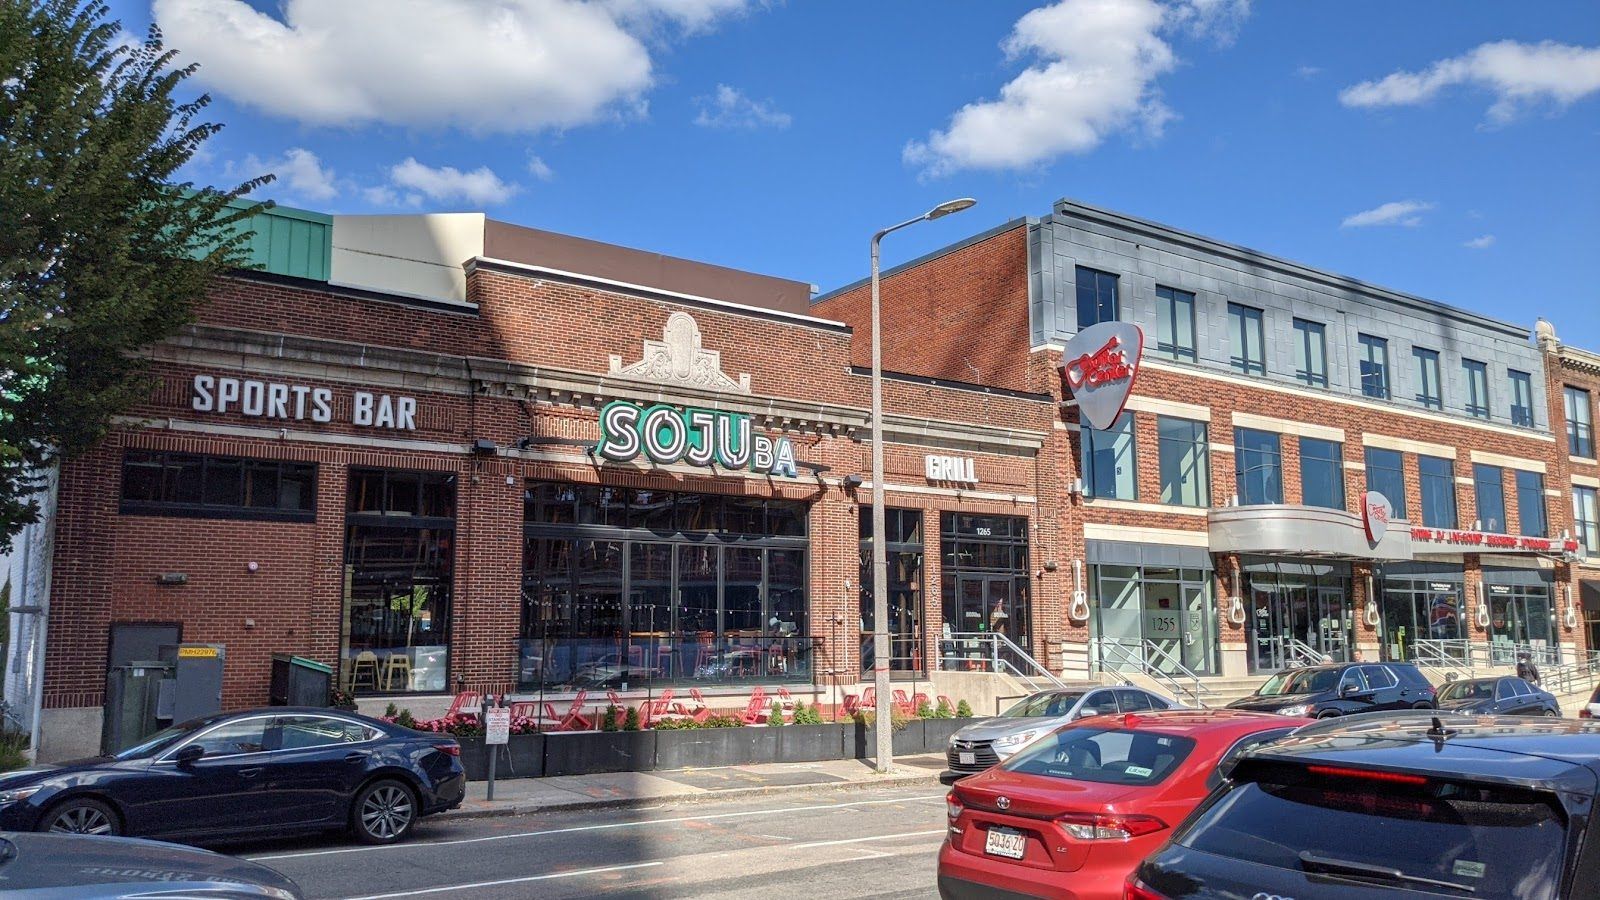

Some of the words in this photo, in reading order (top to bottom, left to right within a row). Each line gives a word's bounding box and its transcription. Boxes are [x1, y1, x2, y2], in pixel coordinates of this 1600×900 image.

[192, 374, 333, 424] SPORTS
[353, 391, 417, 431] BAR
[925, 455, 979, 482] GRILL
[976, 527, 992, 536] 1265
[1152, 616, 1175, 632] 1255
